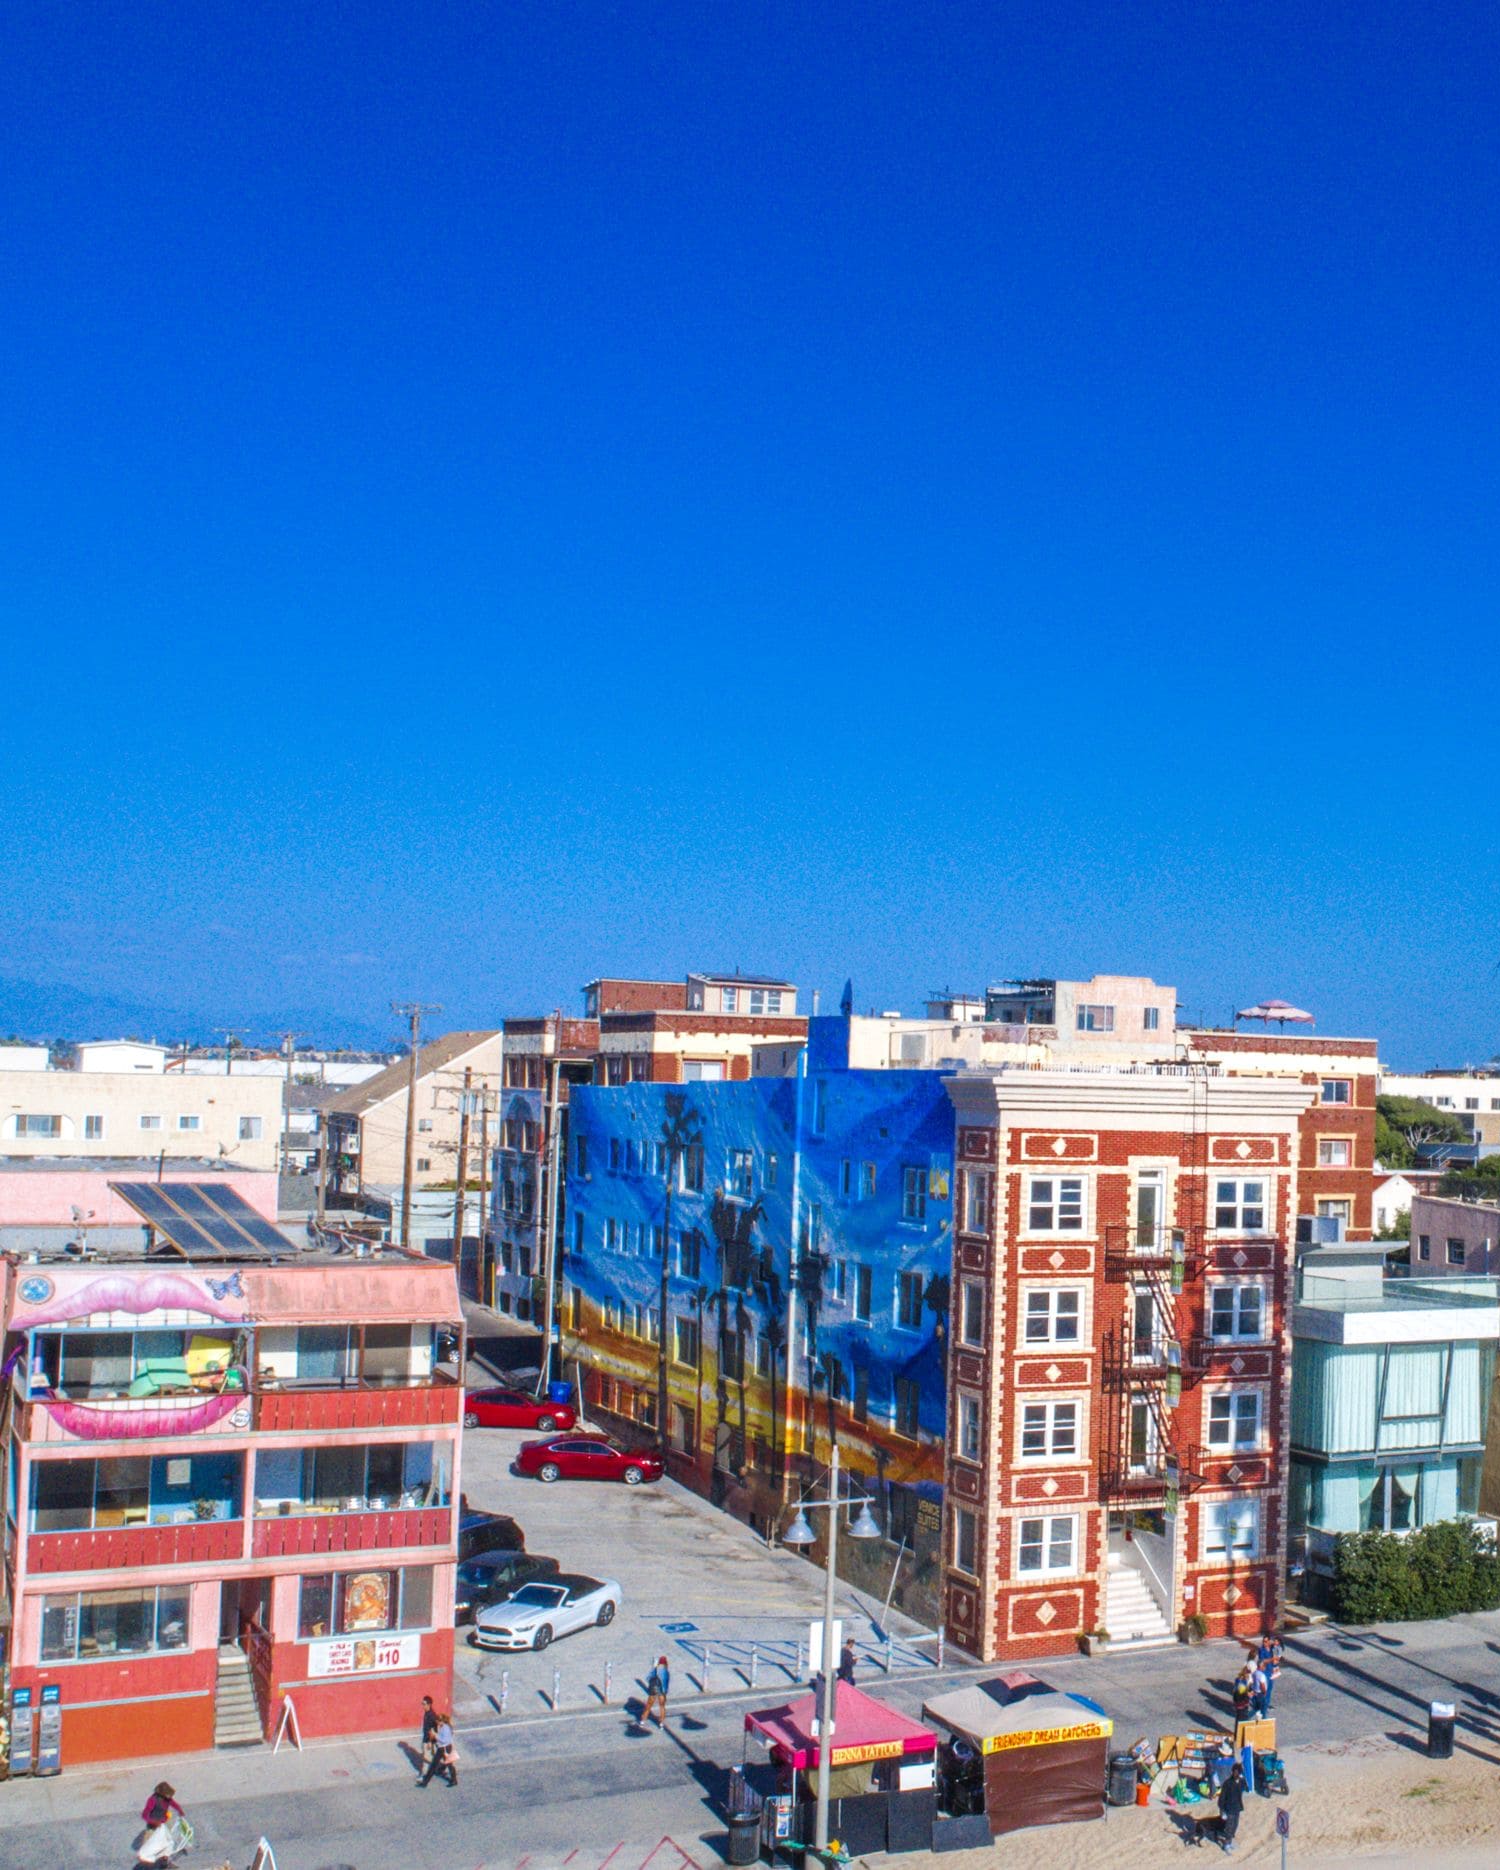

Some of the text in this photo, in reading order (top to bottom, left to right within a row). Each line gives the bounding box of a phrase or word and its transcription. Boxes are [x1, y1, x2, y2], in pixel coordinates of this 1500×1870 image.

[378, 1649, 400, 1666] $10
[993, 1724, 1101, 1749] FRIENDSHIP DREAM CATCHERS
[863, 1743, 902, 1758] TATTOOS
